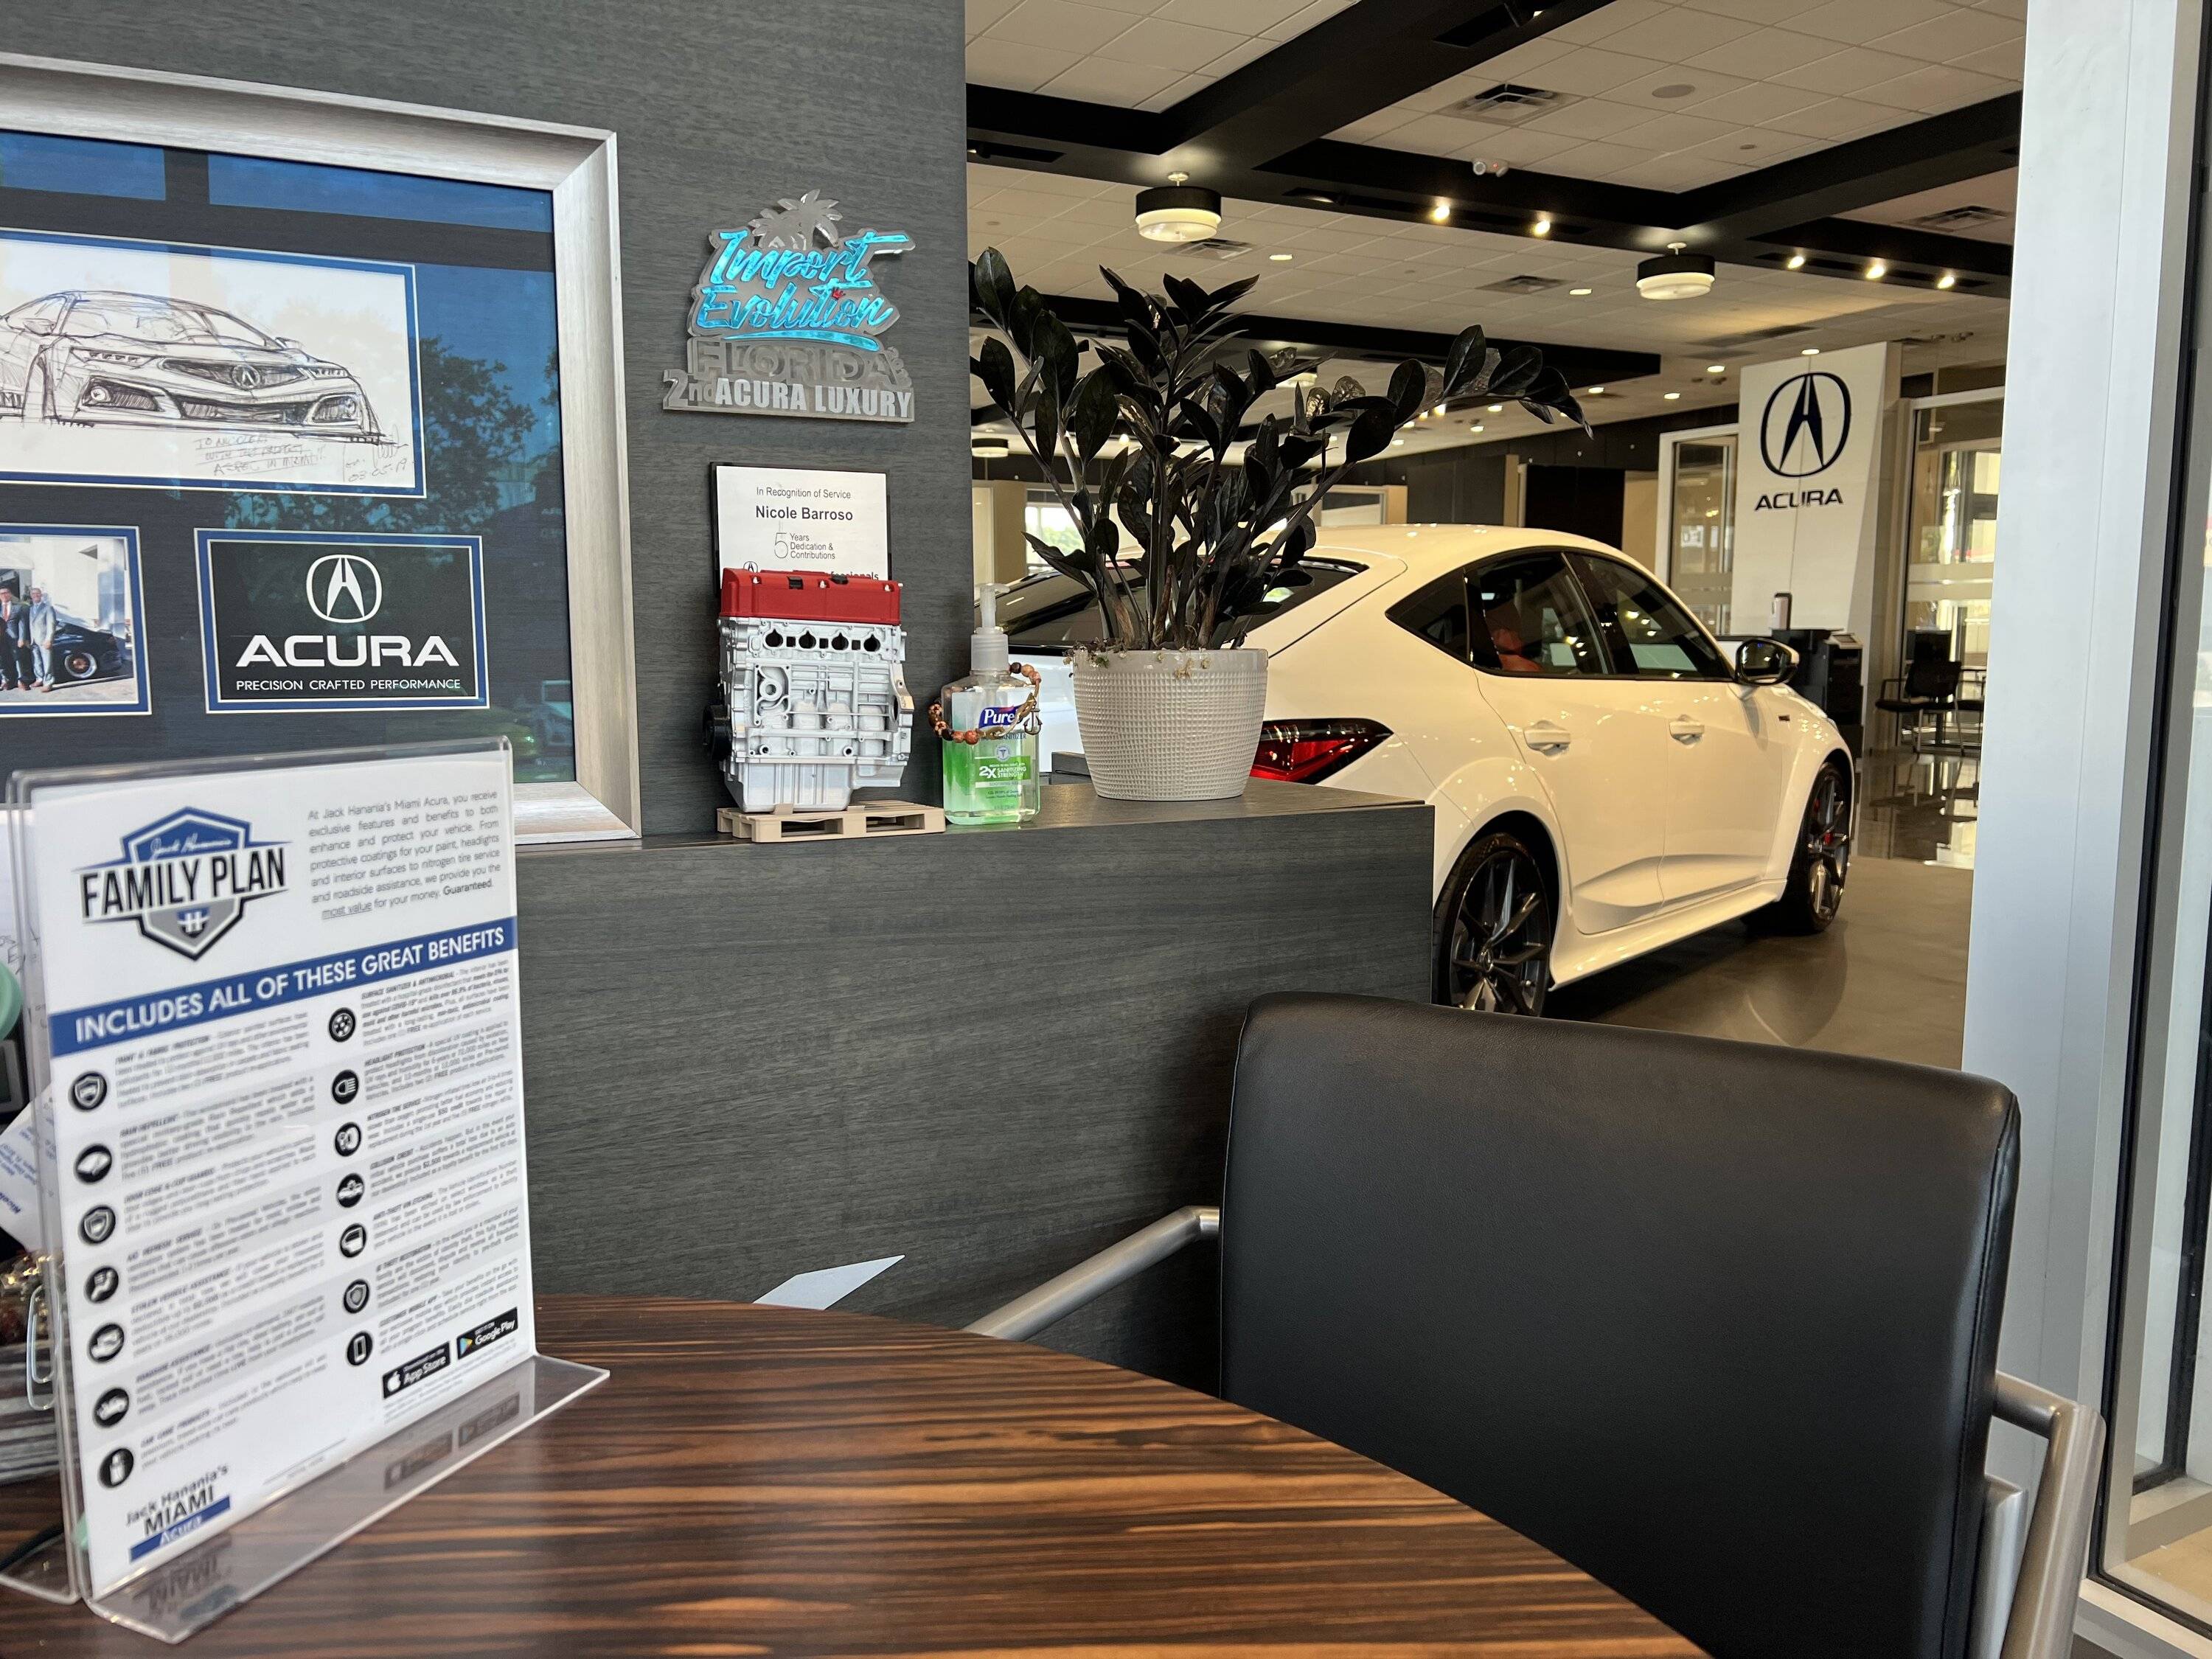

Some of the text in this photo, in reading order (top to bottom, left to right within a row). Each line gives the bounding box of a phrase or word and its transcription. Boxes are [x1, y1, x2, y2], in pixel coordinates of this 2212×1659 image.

[709, 229, 910, 290] Import
[696, 278, 894, 330] Evolution
[714, 378, 807, 411] ACURA
[814, 385, 912, 419] LUXURY
[756, 487, 852, 499] In Recognition of Service
[1754, 488, 1843, 511] ACURA
[756, 506, 853, 521] Nicole Barroso
[774, 532, 810, 559] 5 Years
[790, 542, 834, 551] Dedication &
[790, 551, 835, 560] Contributions
[236, 635, 459, 667] ACURA
[236, 678, 461, 691] PRECISION CRAFTED PERFORMANCE
[984, 709, 1016, 724] Pure
[308, 790, 498, 820] At Jack Hanania's Miami Acura, you receive
[308, 804, 498, 837] exclusive features and benefits to both
[309, 840, 351, 854] enhance
[358, 835, 376, 847] and
[381, 831, 414, 846] protect
[420, 829, 439, 841] your
[479, 818, 500, 830] From
[310, 855, 358, 872] protective
[360, 849, 398, 863] coatings
[399, 845, 414, 857] for
[414, 844, 434, 856] your
[460, 834, 500, 849] headlights
[311, 849, 501, 886] and interior surfaces to nitrogen tire service
[80, 847, 287, 919] FAMILY PLAN
[312, 891, 331, 903] and
[333, 885, 375, 900] roadside
[425, 874, 437, 884] we
[439, 867, 470, 883] provide
[472, 866, 487, 877] you
[488, 863, 501, 873] the
[321, 906, 346, 919] most
[348, 900, 372, 914] value
[374, 897, 387, 909] for
[389, 895, 408, 908] your
[75, 927, 505, 1043] INCLUDES ALL OF THESE GREAT BENEFITS
[474, 1327, 501, 1346] Google
[125, 1464, 229, 1527] Jack Hanania's
[143, 1485, 215, 1538] MIAMI
